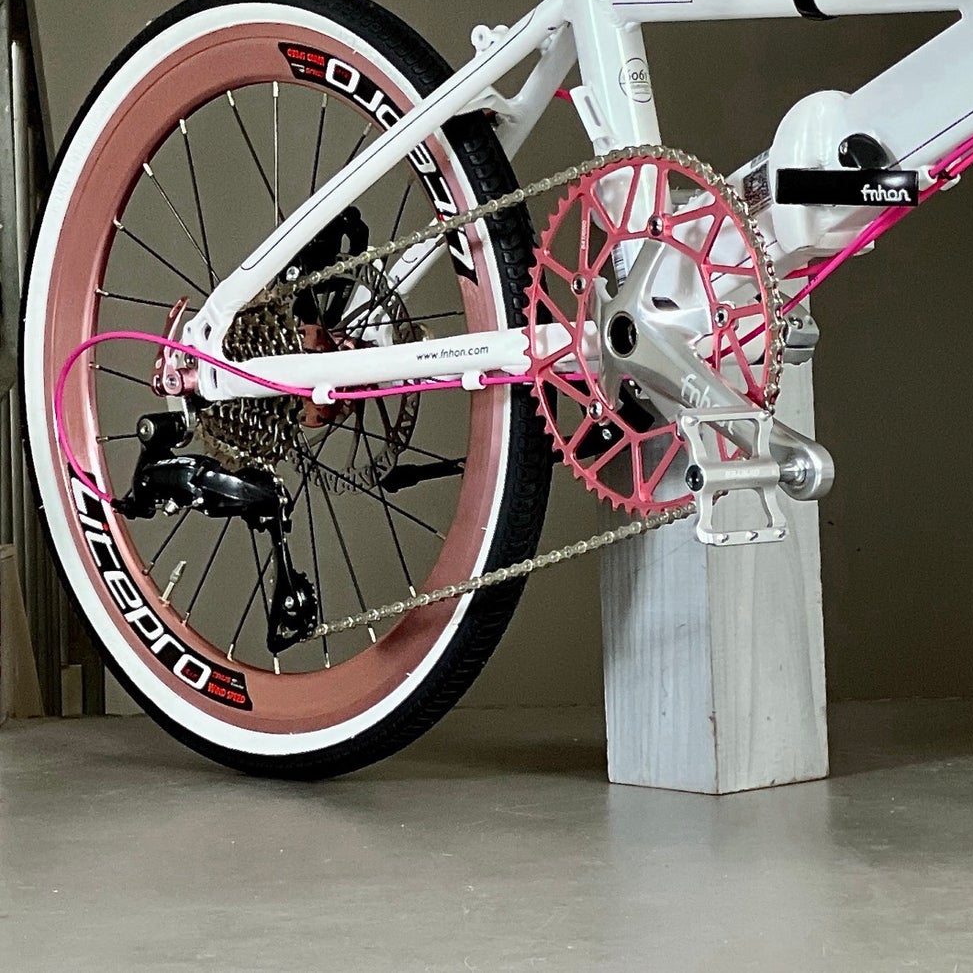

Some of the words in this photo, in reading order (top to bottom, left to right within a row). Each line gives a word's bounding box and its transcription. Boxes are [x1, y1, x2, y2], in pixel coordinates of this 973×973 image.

[861, 184, 911, 202] fnhon
[416, 346, 489, 361] www.fnhon.com
[71, 477, 211, 690] Litepro
